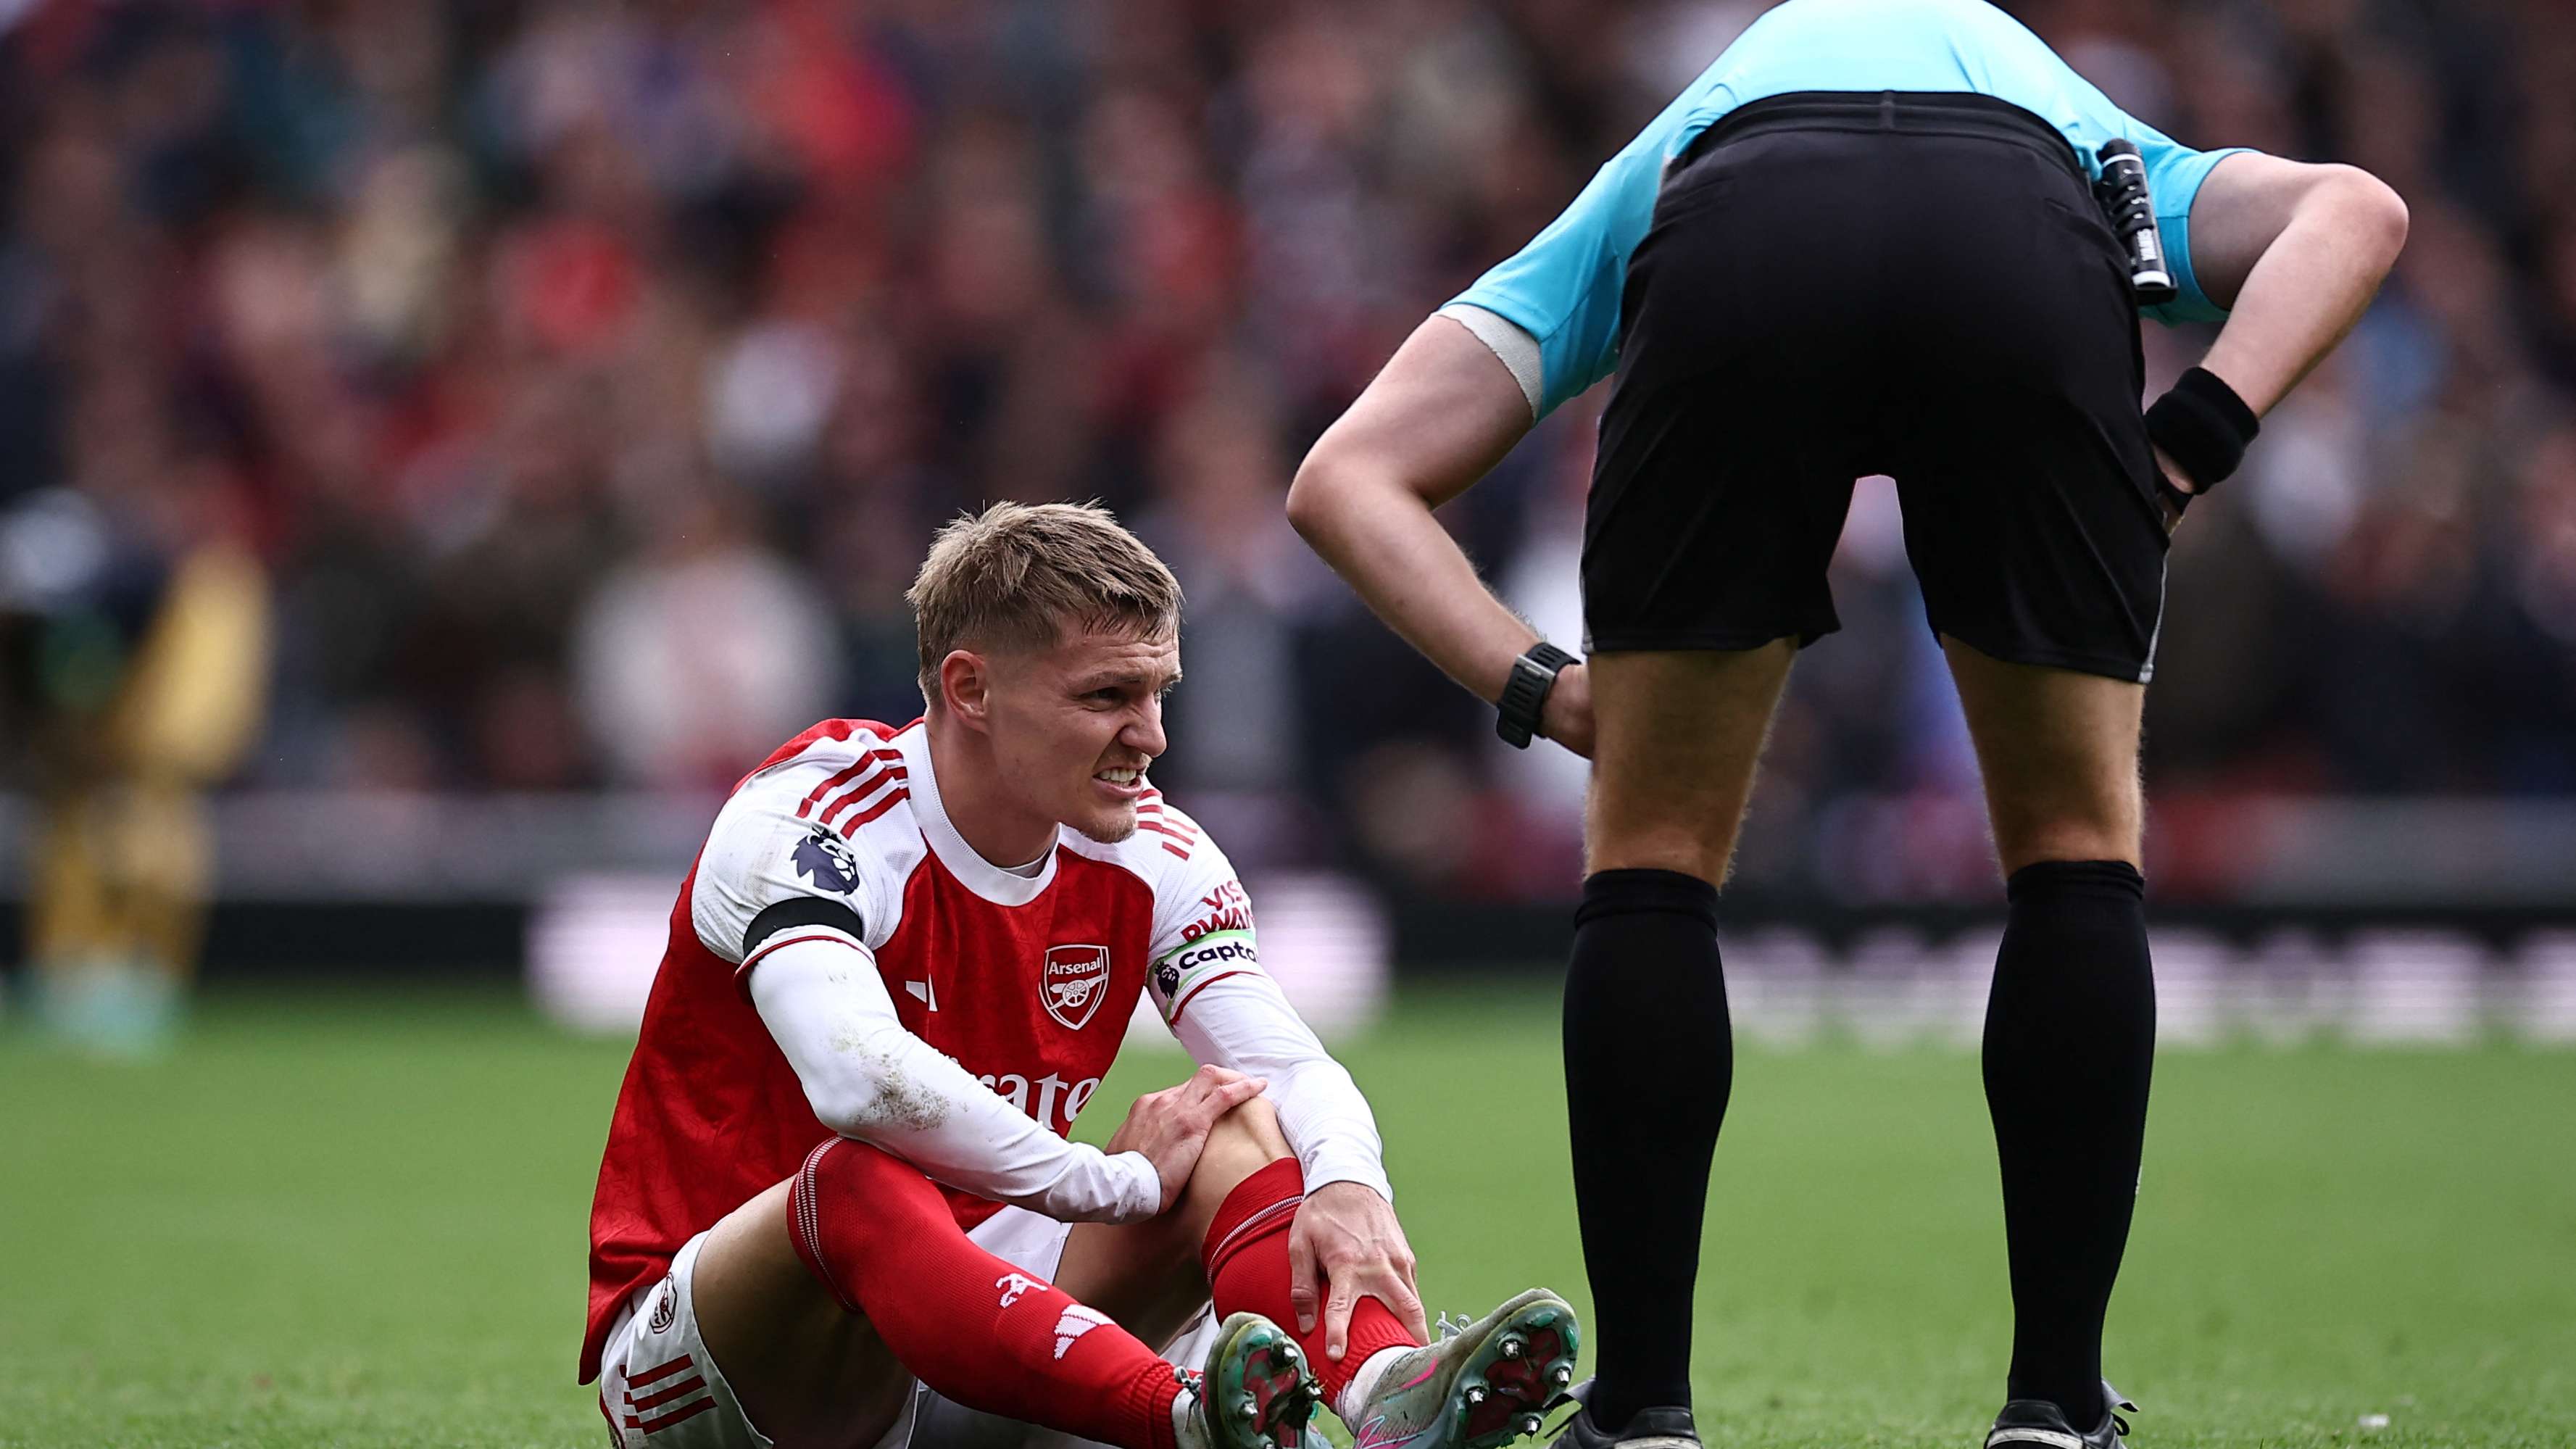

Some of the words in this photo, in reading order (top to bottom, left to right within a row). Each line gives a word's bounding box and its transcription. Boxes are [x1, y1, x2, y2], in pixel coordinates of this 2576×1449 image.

[1201, 880, 1242, 910] VIS
[1049, 958, 1101, 975] Arsenal
[1179, 942, 1258, 970] Capta
